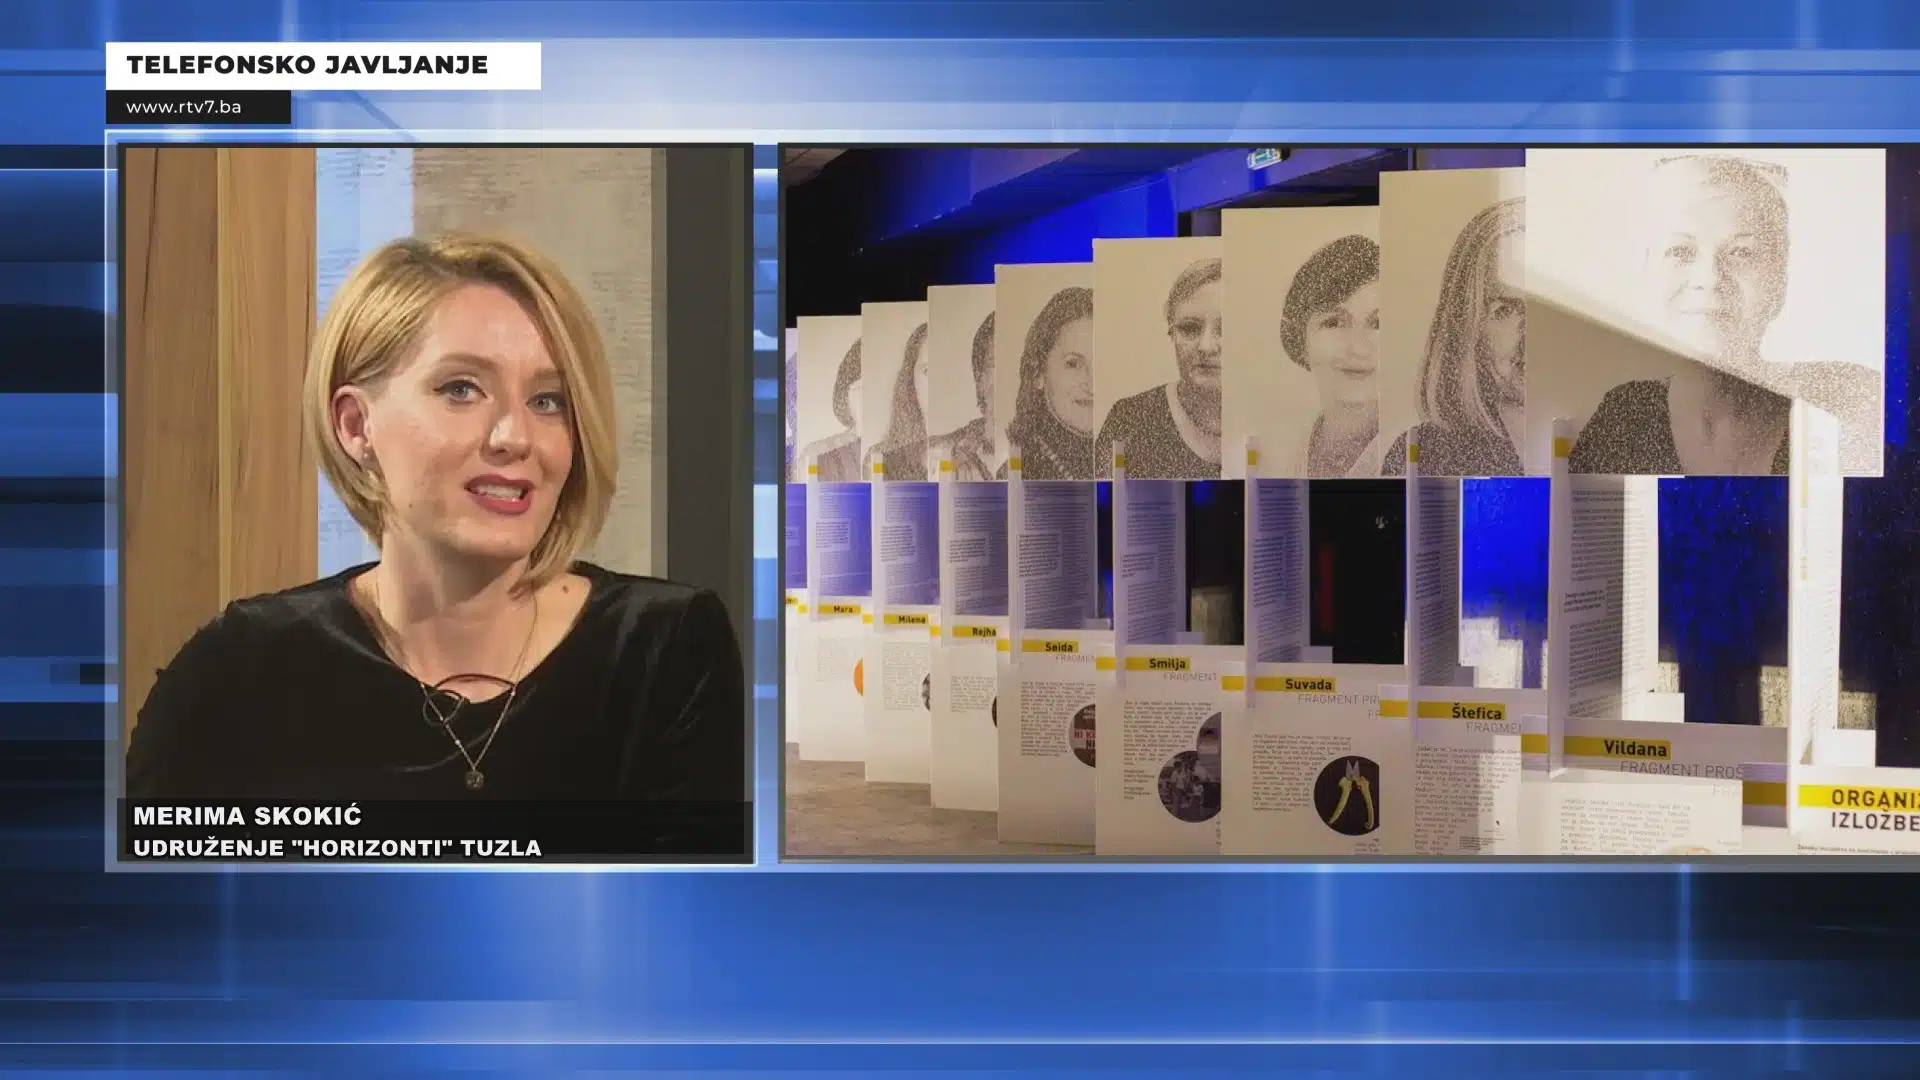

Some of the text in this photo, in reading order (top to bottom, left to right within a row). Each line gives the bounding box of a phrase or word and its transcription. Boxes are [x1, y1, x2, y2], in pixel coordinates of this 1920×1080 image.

[833, 605, 854, 613] Mara
[898, 615, 926, 625] Milena
[1045, 642, 1073, 652] Seida
[1149, 658, 1186, 671] Smilja
[1163, 672, 1217, 682] FRAGMENT
[1285, 678, 1332, 691] Suvada
[1298, 693, 1359, 706] FRAGMENT
[1451, 702, 1502, 720] Štefica
[1465, 721, 1522, 734] FRAGME
[1603, 739, 1668, 757] Vildana
[1620, 760, 1701, 777] FRAGMENT
[1831, 788, 1920, 809] ORGANI
[1831, 807, 1920, 832] IZLOŽBE
